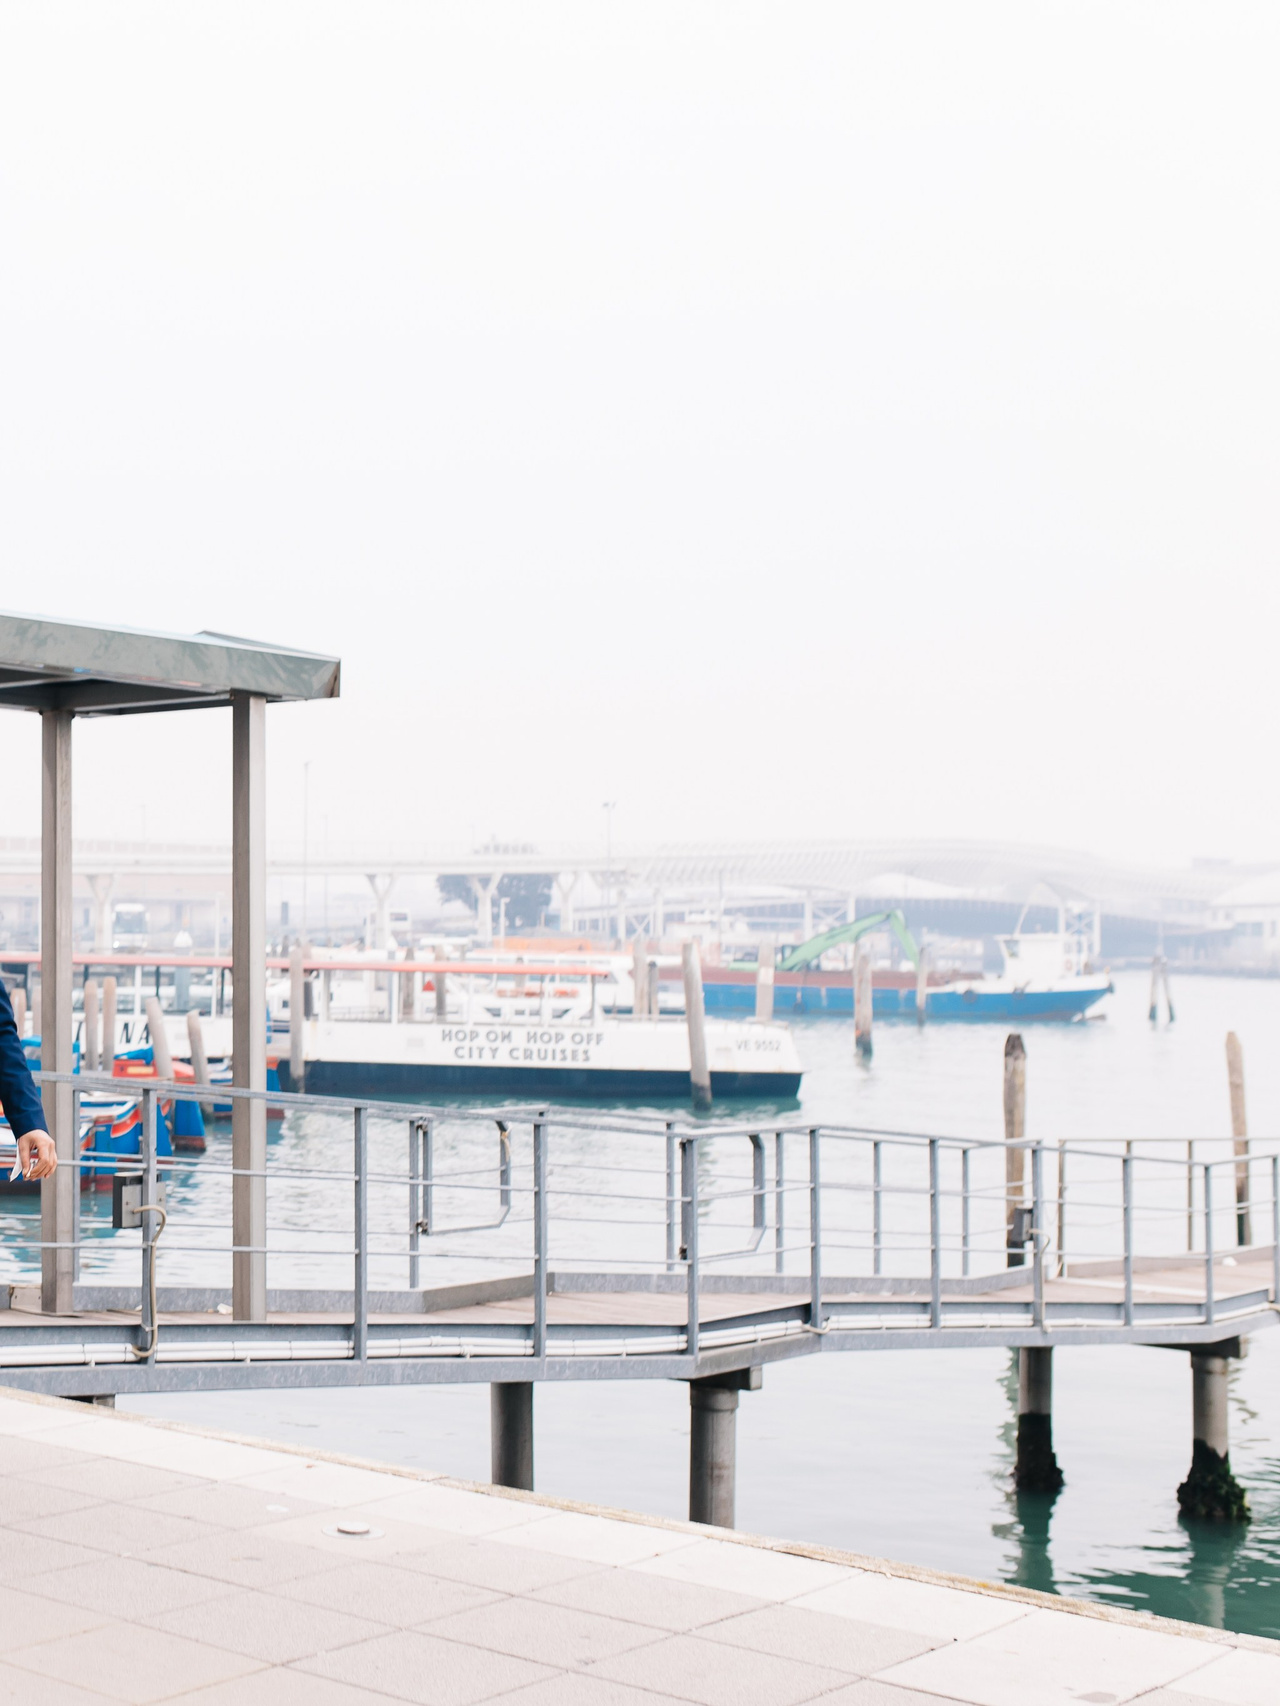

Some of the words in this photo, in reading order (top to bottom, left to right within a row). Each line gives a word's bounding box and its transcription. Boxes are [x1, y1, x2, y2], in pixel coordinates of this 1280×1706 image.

[441, 1029, 479, 1043] HOP
[485, 1030, 513, 1043] ON
[526, 1031, 565, 1045] HOP
[571, 1032, 604, 1045] OFF
[454, 1046, 500, 1060] CITY
[508, 1047, 591, 1062] CRUISES
